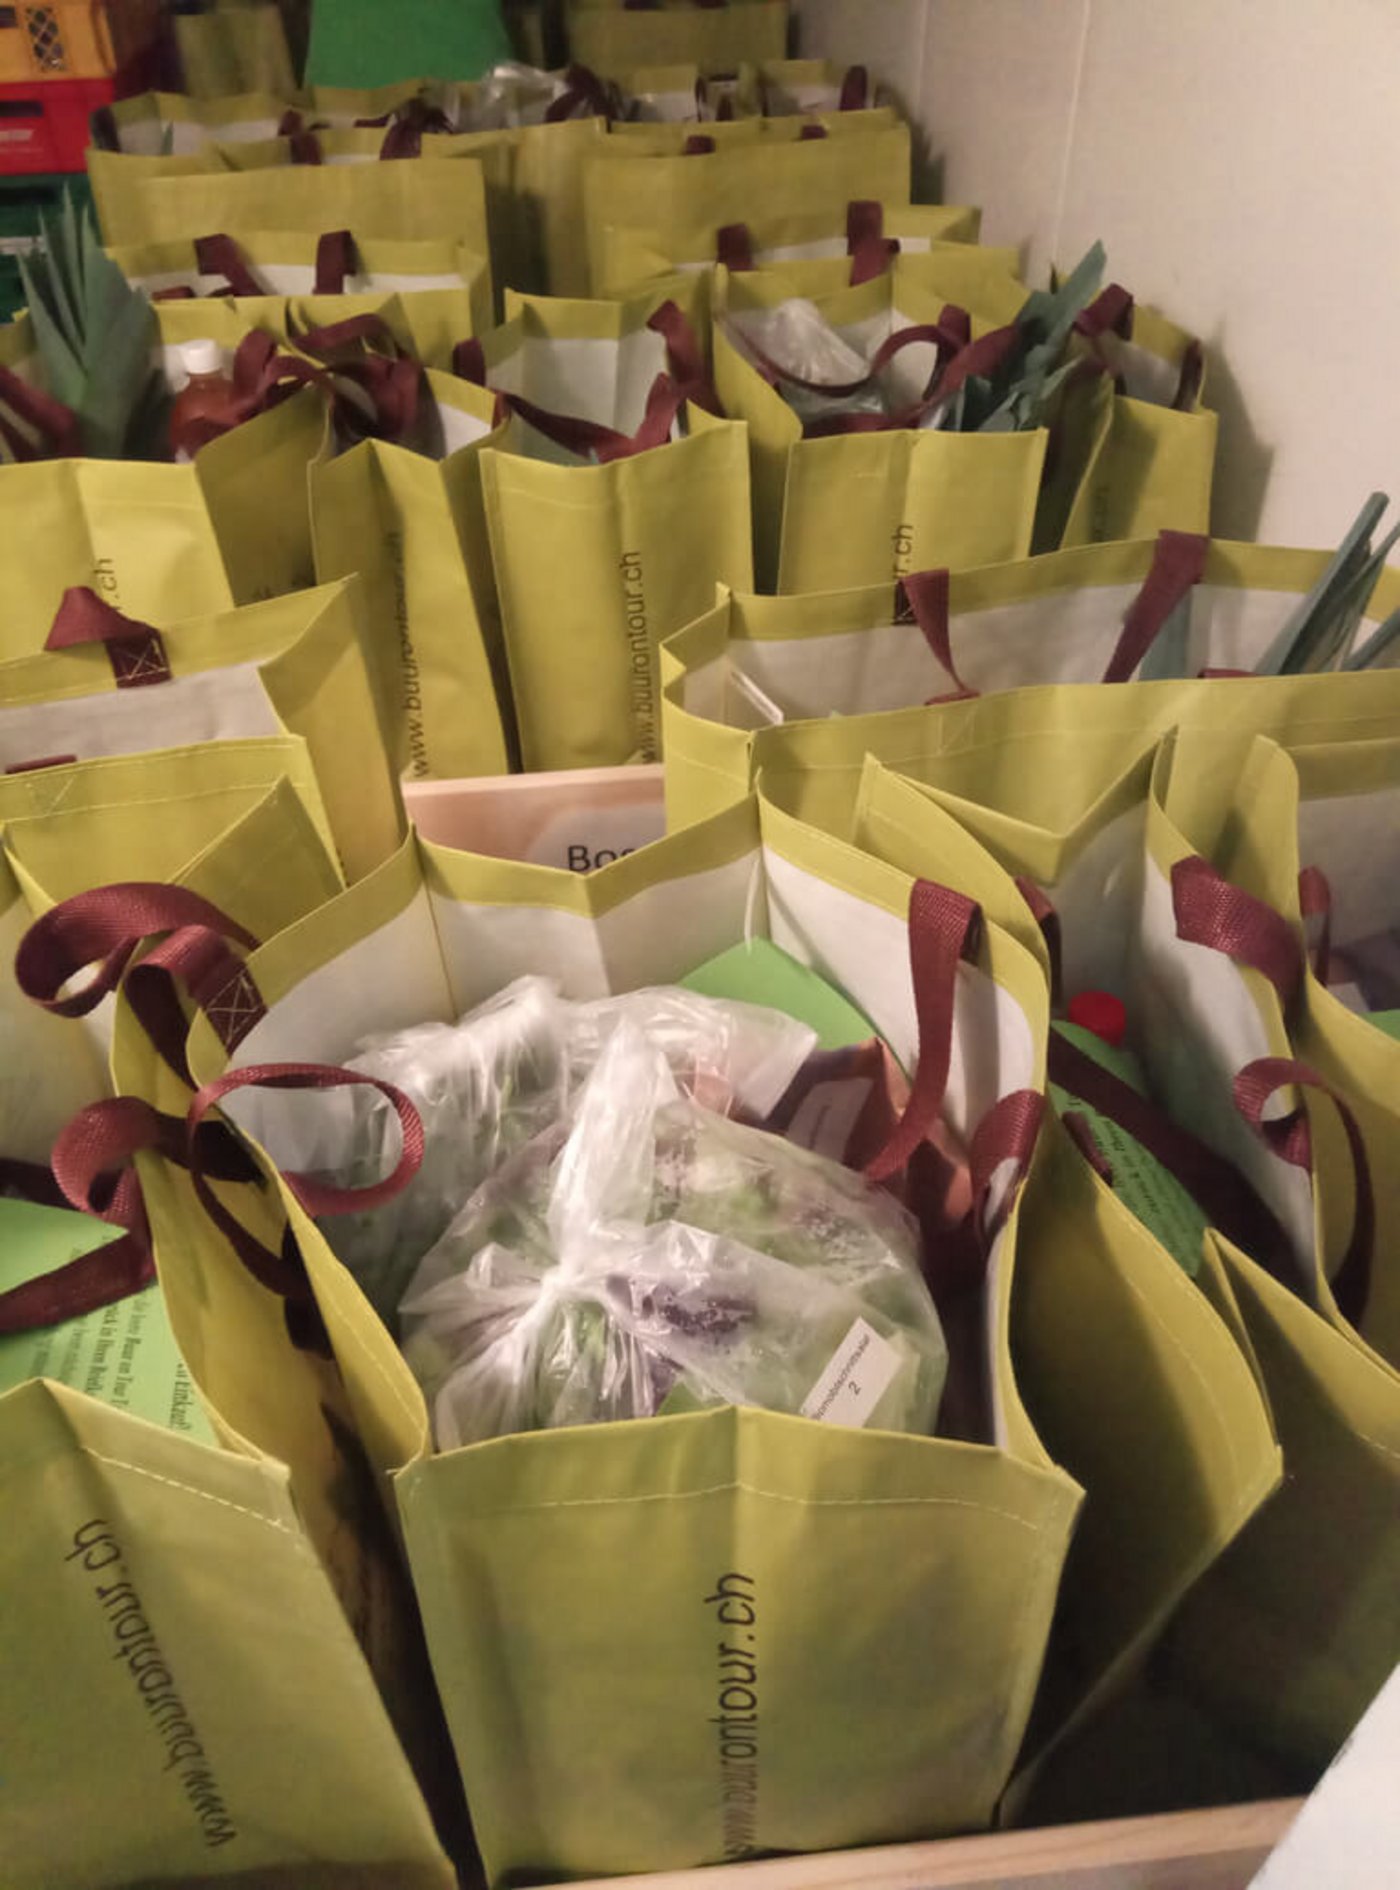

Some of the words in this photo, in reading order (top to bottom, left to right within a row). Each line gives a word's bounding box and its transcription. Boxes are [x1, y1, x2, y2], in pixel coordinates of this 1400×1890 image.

[567, 844, 636, 872] Bo
[64, 1518, 237, 1848] www.buurontour.ch
[703, 1573, 758, 1857] www.buurontour.ch
